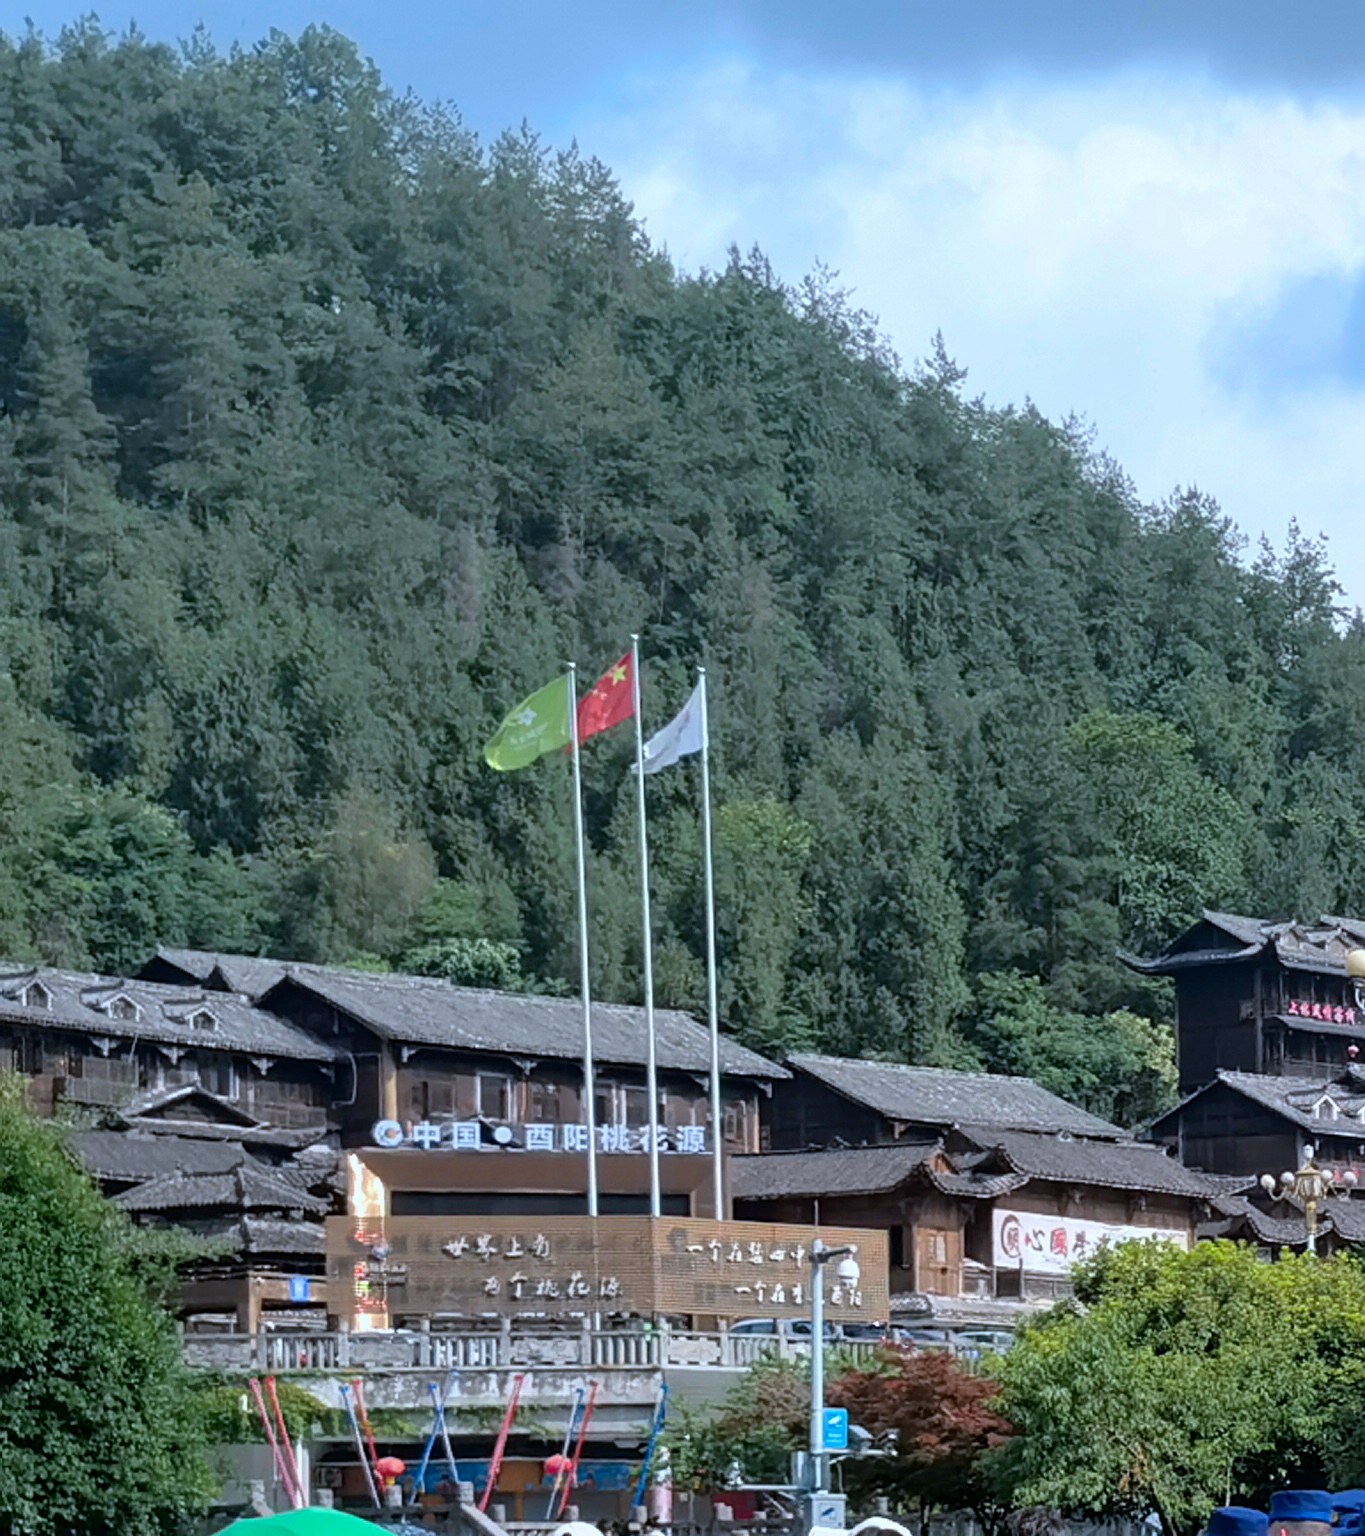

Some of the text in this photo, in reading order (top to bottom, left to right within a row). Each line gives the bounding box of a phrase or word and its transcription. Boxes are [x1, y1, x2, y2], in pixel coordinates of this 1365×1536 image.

[483, 1270, 623, 1300] 两个桃花源
[734, 1280, 863, 1307] 一个在重酉阳
